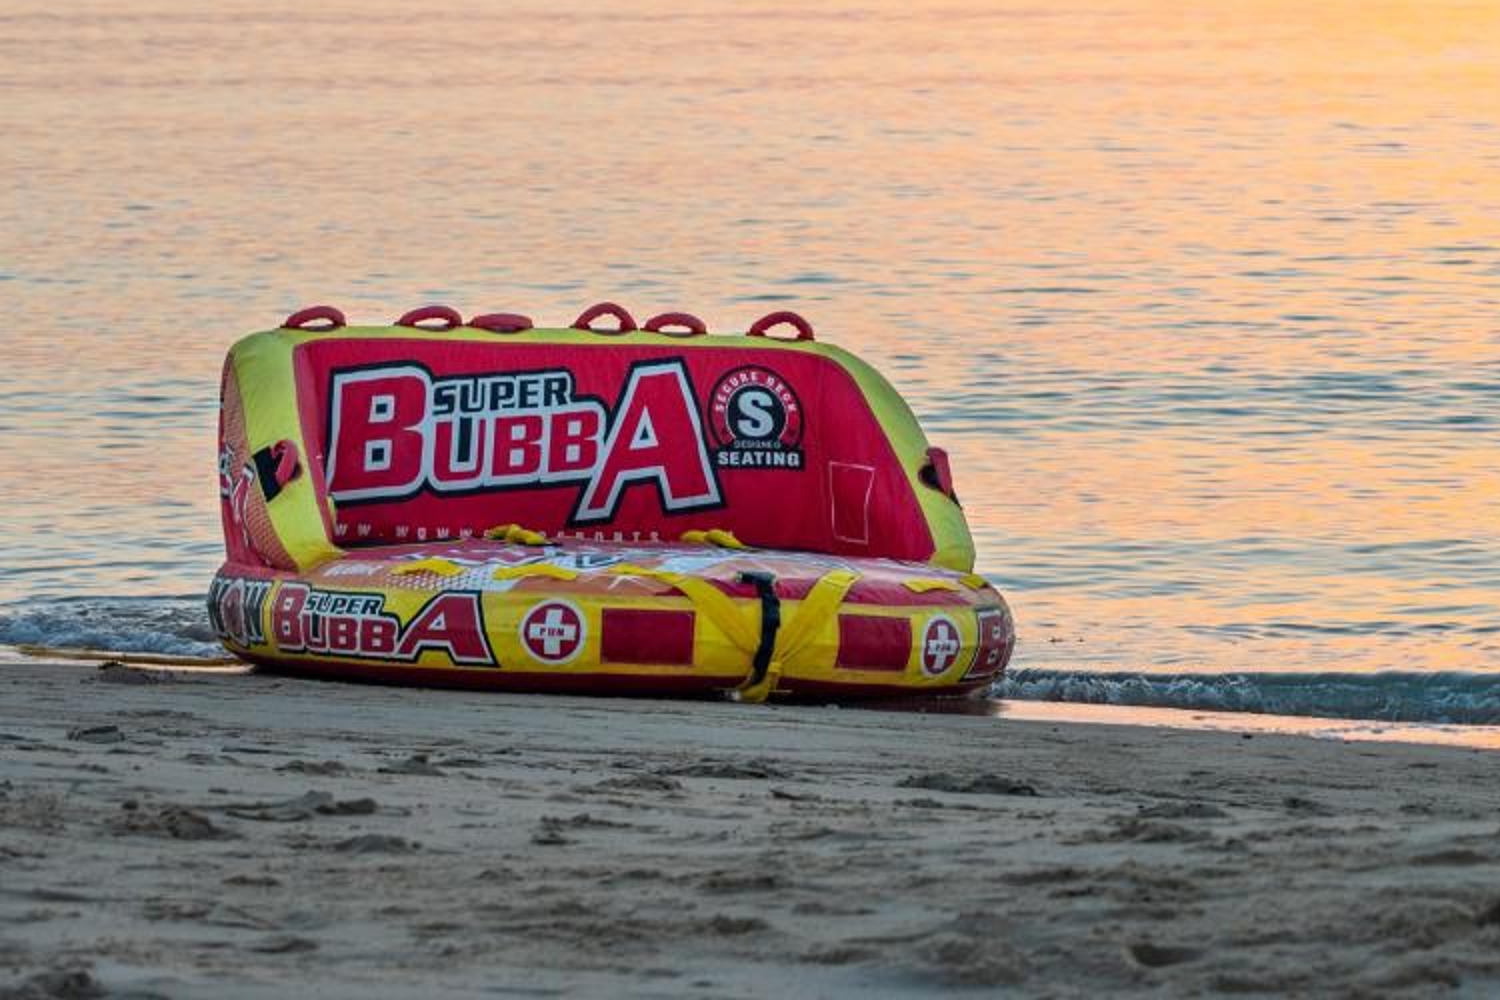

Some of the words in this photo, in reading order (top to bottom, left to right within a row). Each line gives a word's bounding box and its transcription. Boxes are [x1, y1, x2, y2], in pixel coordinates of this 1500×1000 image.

[432, 375, 569, 416] SUPER
[715, 371, 760, 412] SECURE
[737, 390, 774, 438] S
[326, 356, 726, 527] BUBBA
[717, 450, 800, 468] SEATING
[273, 582, 499, 666] BUBBA
[303, 593, 383, 616] SUPER
